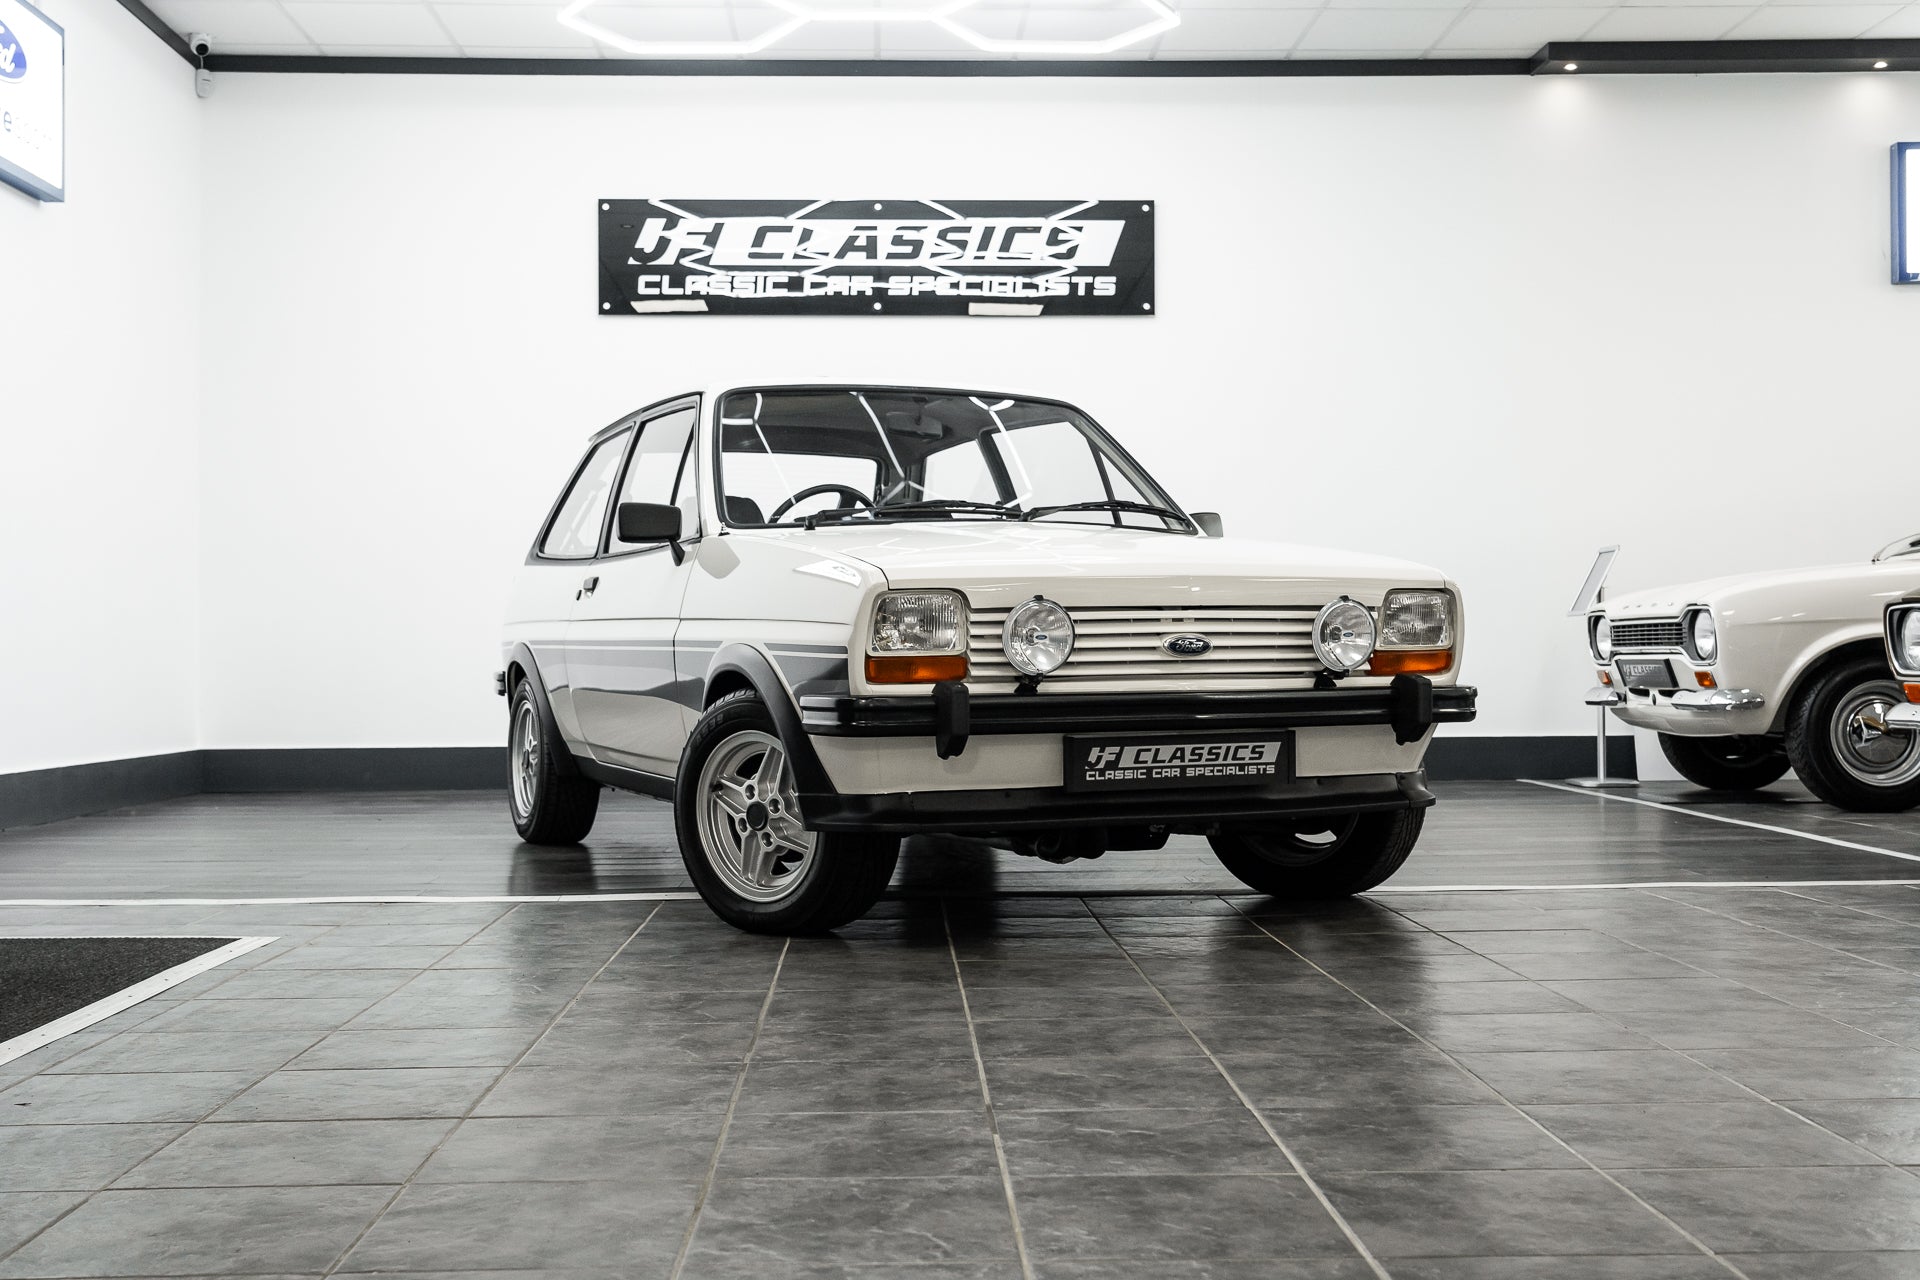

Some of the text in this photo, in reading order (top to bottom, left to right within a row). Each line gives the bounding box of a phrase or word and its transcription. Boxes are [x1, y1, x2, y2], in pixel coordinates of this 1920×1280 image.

[747, 225, 1084, 260] CLASSICS
[637, 275, 1118, 297] CLASSIC CAR SPECIALISTS
[1133, 744, 1266, 765] CLASSICS
[1086, 765, 1275, 781] CLASSIC CAR SPECIALISTS
